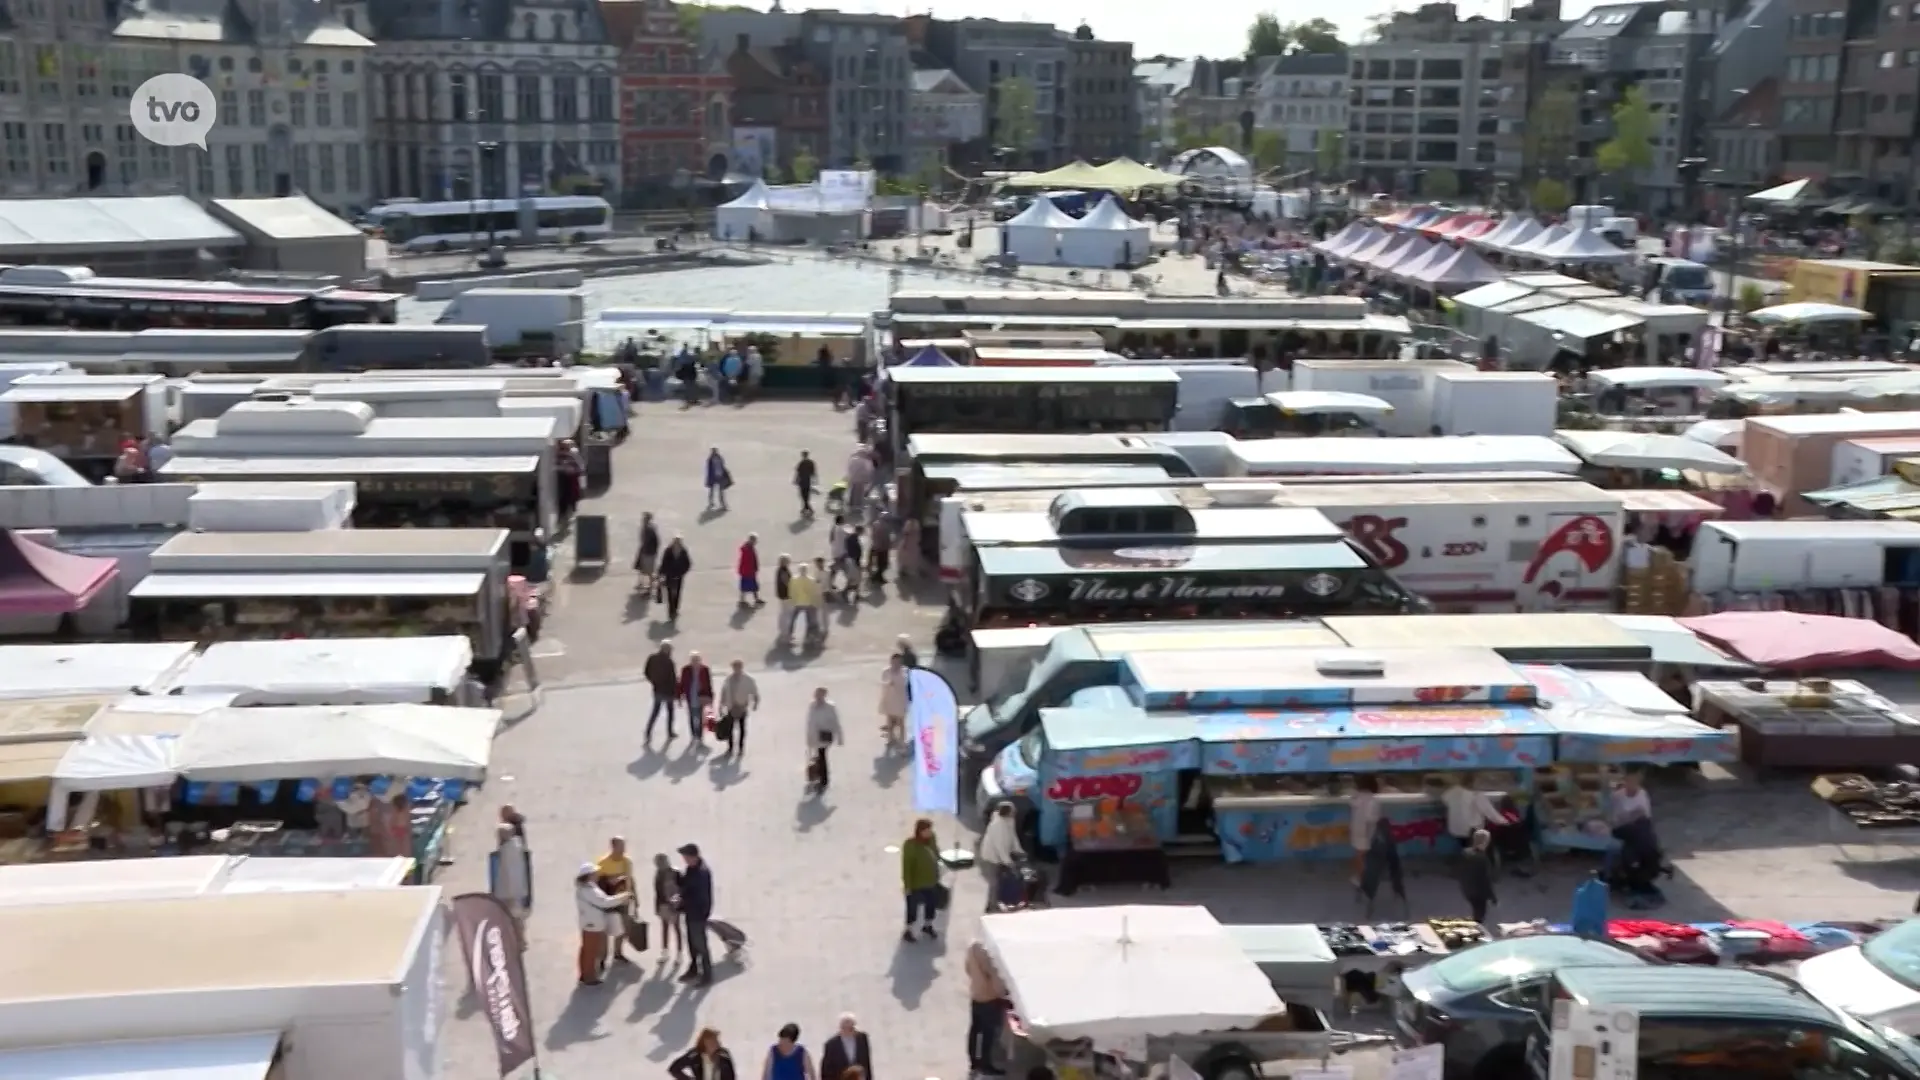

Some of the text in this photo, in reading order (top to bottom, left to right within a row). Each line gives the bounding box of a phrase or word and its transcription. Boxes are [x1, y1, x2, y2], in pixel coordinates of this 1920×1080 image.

[1338, 514, 1409, 568] RS
[1069, 578, 1129, 600] Vlees
[1132, 582, 1155, 599] &
